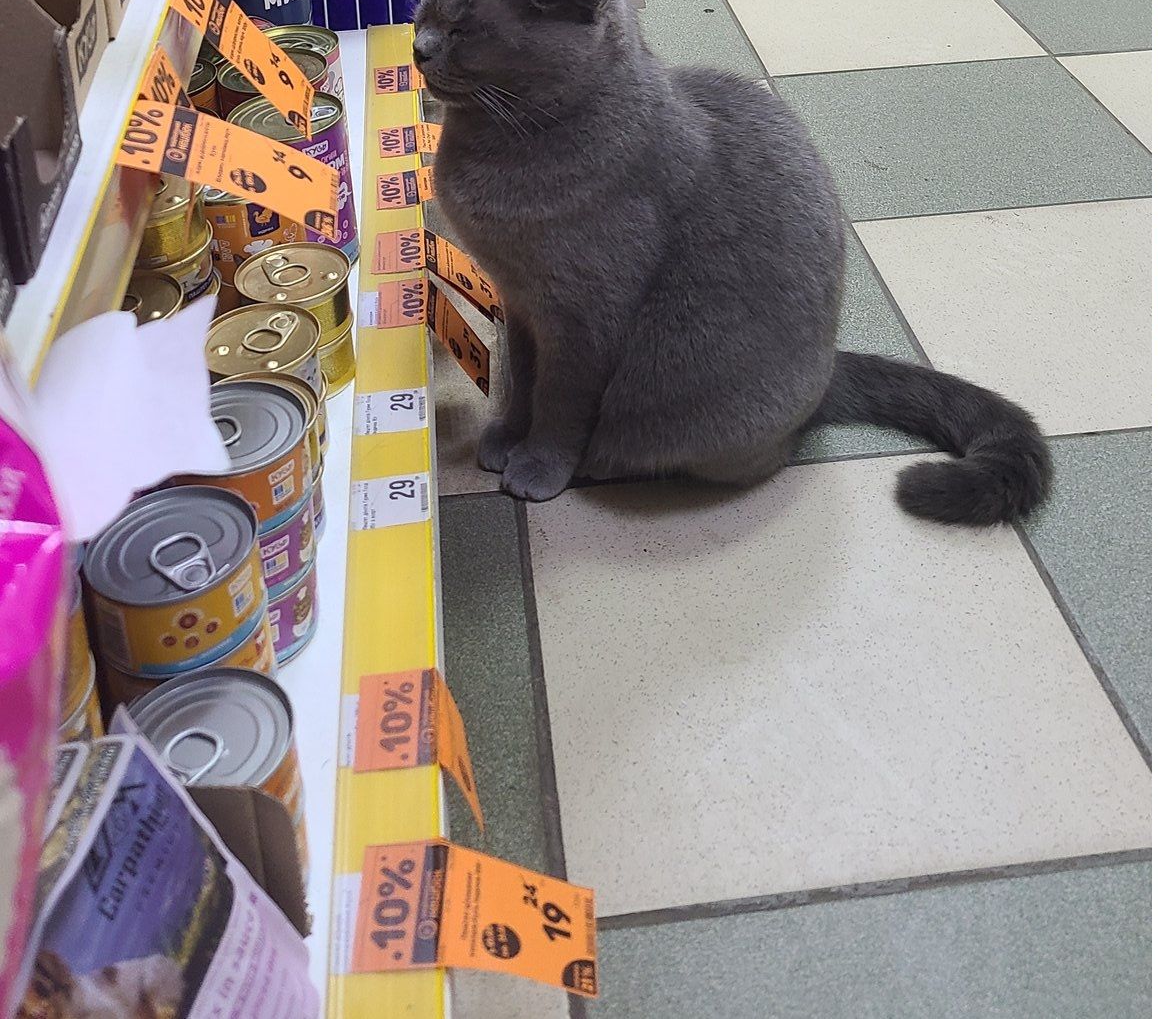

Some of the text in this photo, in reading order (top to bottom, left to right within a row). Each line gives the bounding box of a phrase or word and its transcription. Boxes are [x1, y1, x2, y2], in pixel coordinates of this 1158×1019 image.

[390, 393, 414, 411] 29
[389, 480, 415, 500] 29
[543, 901, 572, 942] 19
